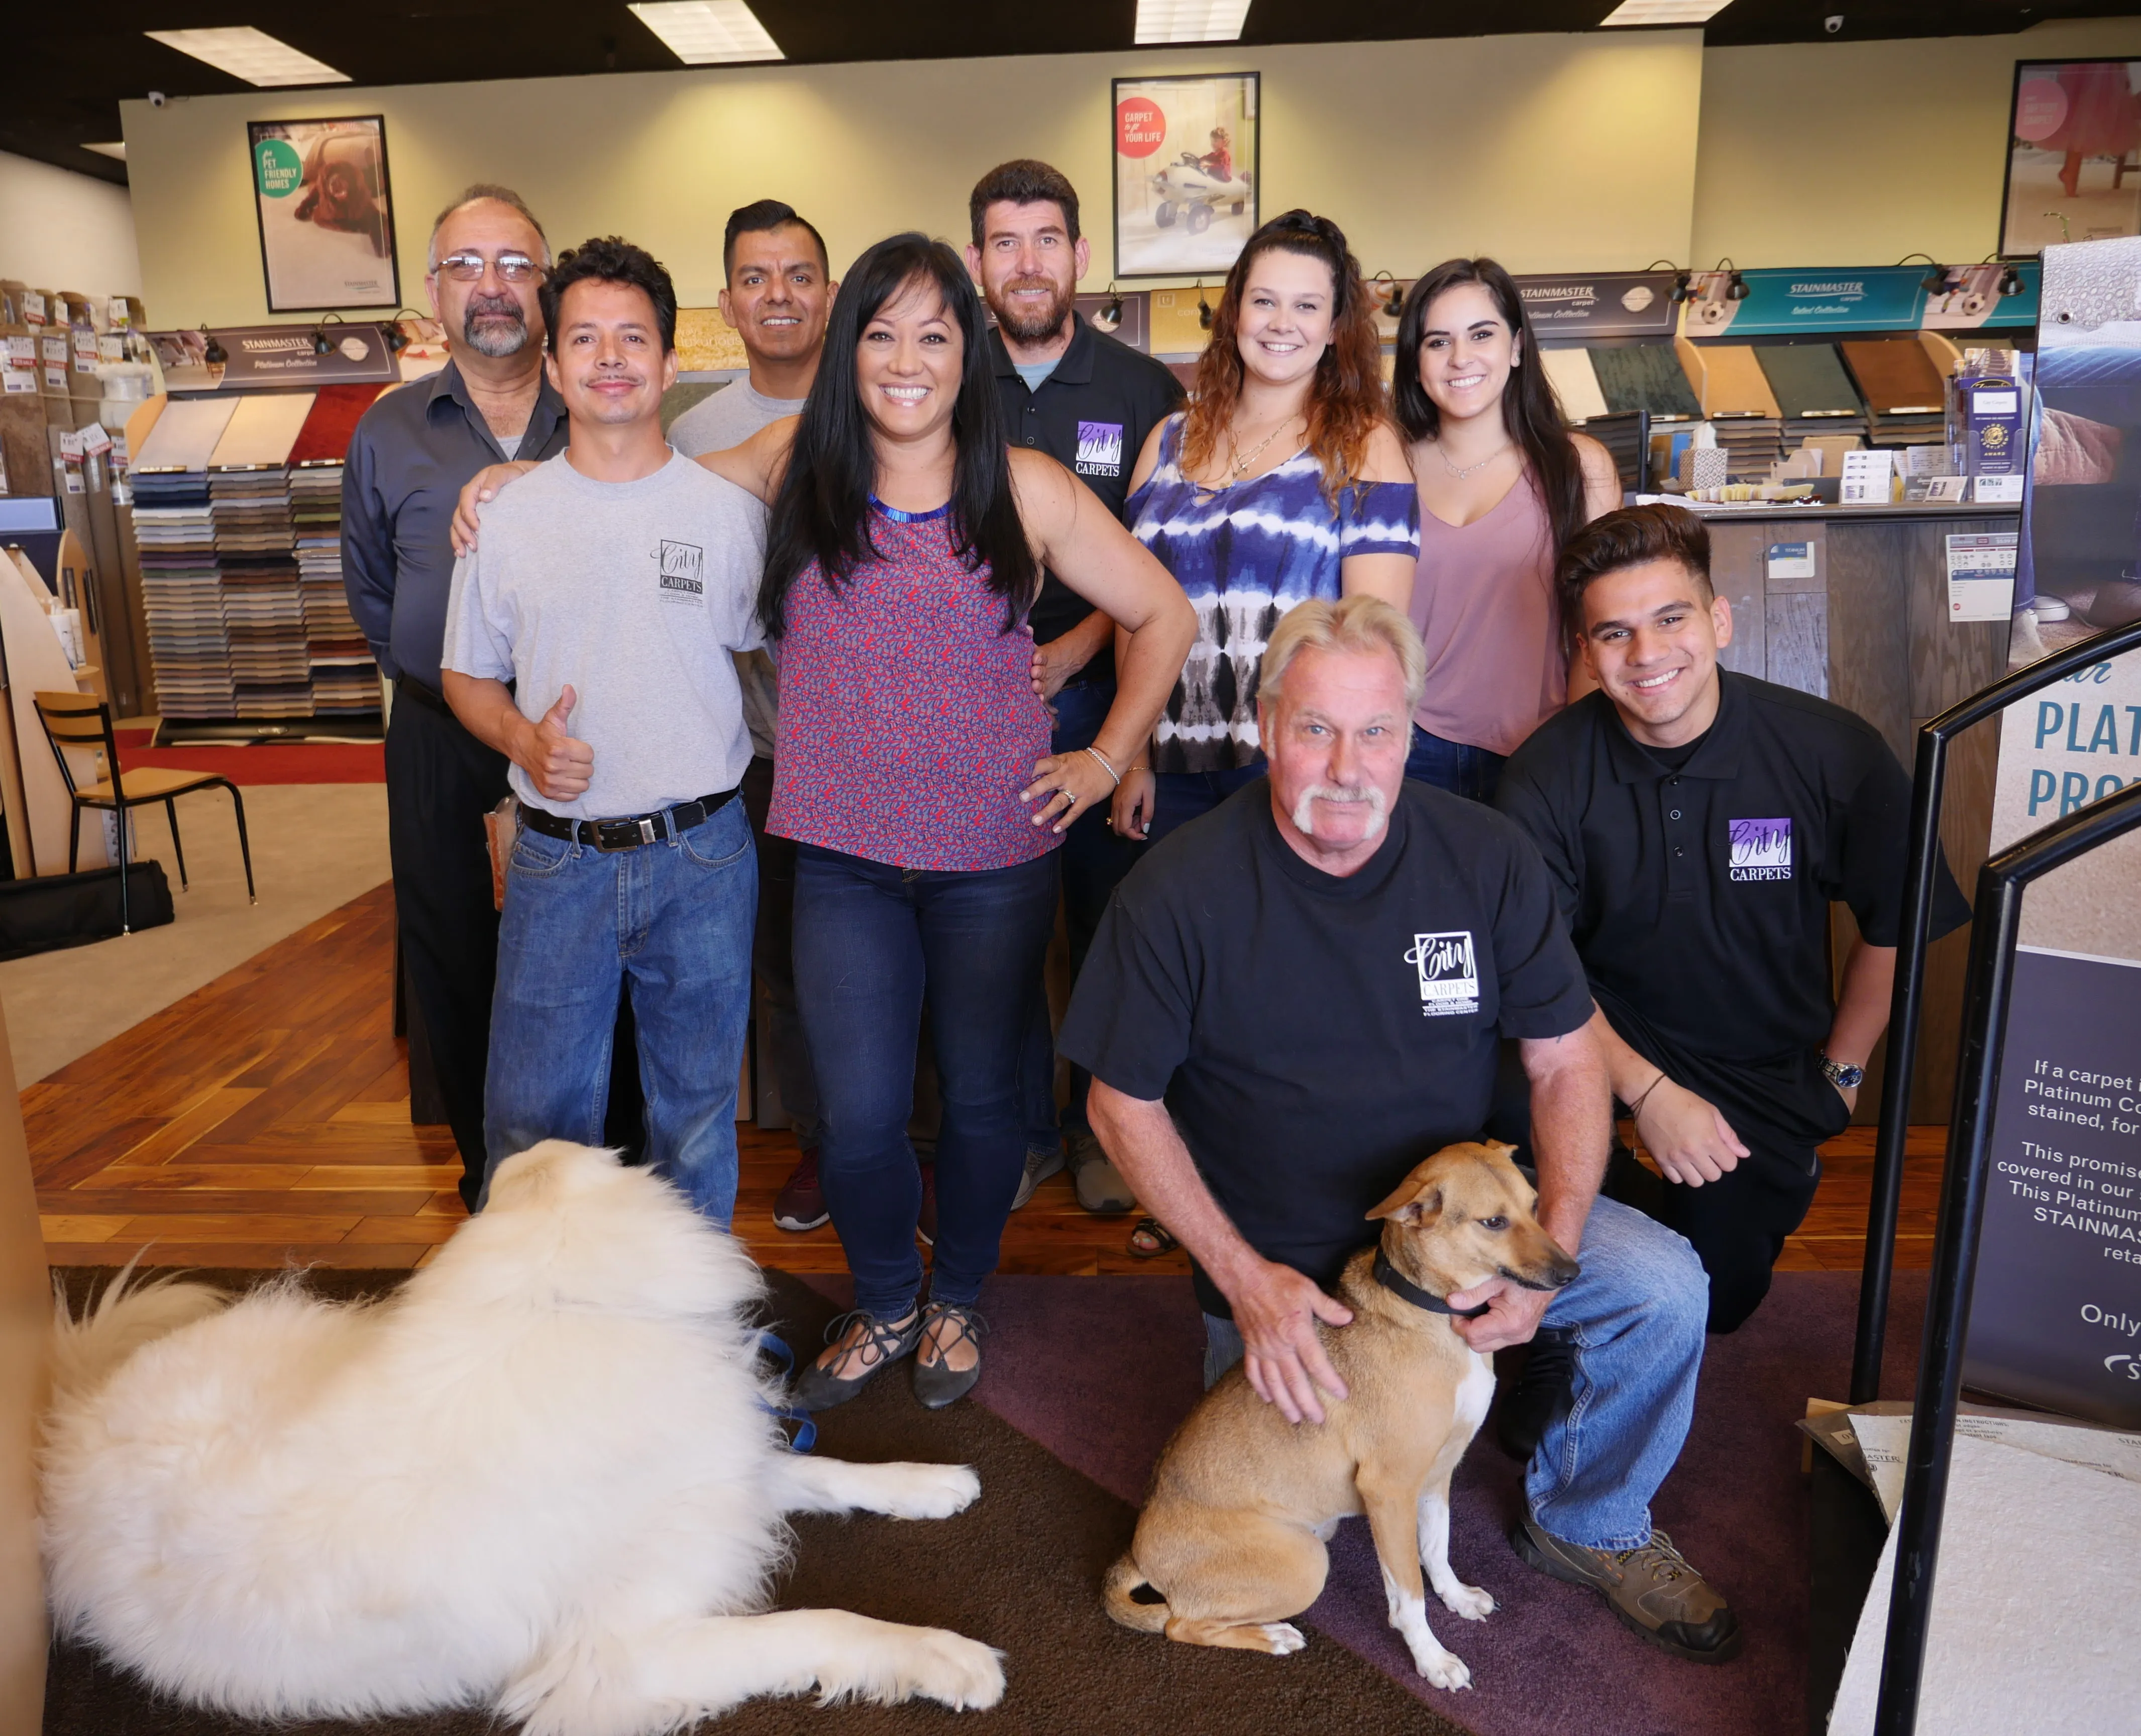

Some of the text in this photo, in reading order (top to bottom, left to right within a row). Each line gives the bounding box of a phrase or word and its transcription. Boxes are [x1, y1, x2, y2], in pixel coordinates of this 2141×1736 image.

[1125, 112, 1153, 123] CARPET
[1130, 123, 1139, 133] fit
[1125, 132, 1161, 143] YOUR LIFE
[264, 158, 275, 169] PET
[265, 168, 296, 179] FRIENDLY
[266, 179, 289, 189] HOMES
[1520, 286, 1594, 298] STAINMASTER
[1790, 282, 1863, 293] STAINMASTER
[1553, 309, 1590, 319] Collection
[242, 338, 311, 350] STAINMASTER
[255, 358, 317, 369] Platinum Collection
[1077, 424, 1121, 462] City
[1076, 462, 1120, 477] CARPETS
[650, 544, 701, 580] City
[662, 576, 702, 593] CARPETS
[1729, 821, 1789, 865] City
[1730, 867, 1791, 881] CARPETS
[1404, 937, 1472, 981] City
[1424, 982, 1475, 997] CARPETS
[2035, 1060, 2049, 1074] If
[2053, 1066, 2063, 1078] a
[2069, 1069, 2133, 1091] carpet
[2024, 1079, 2111, 1108] Platinum
[2028, 1105, 2140, 1135] stained, for
[2022, 1141, 2063, 1162] This
[1997, 1161, 2071, 1185] covered
[2078, 1175, 2094, 1191] in
[2101, 1183, 2133, 1199] our
[2009, 1180, 2141, 1222] This Platinum
[2081, 1304, 2141, 1337] Only
